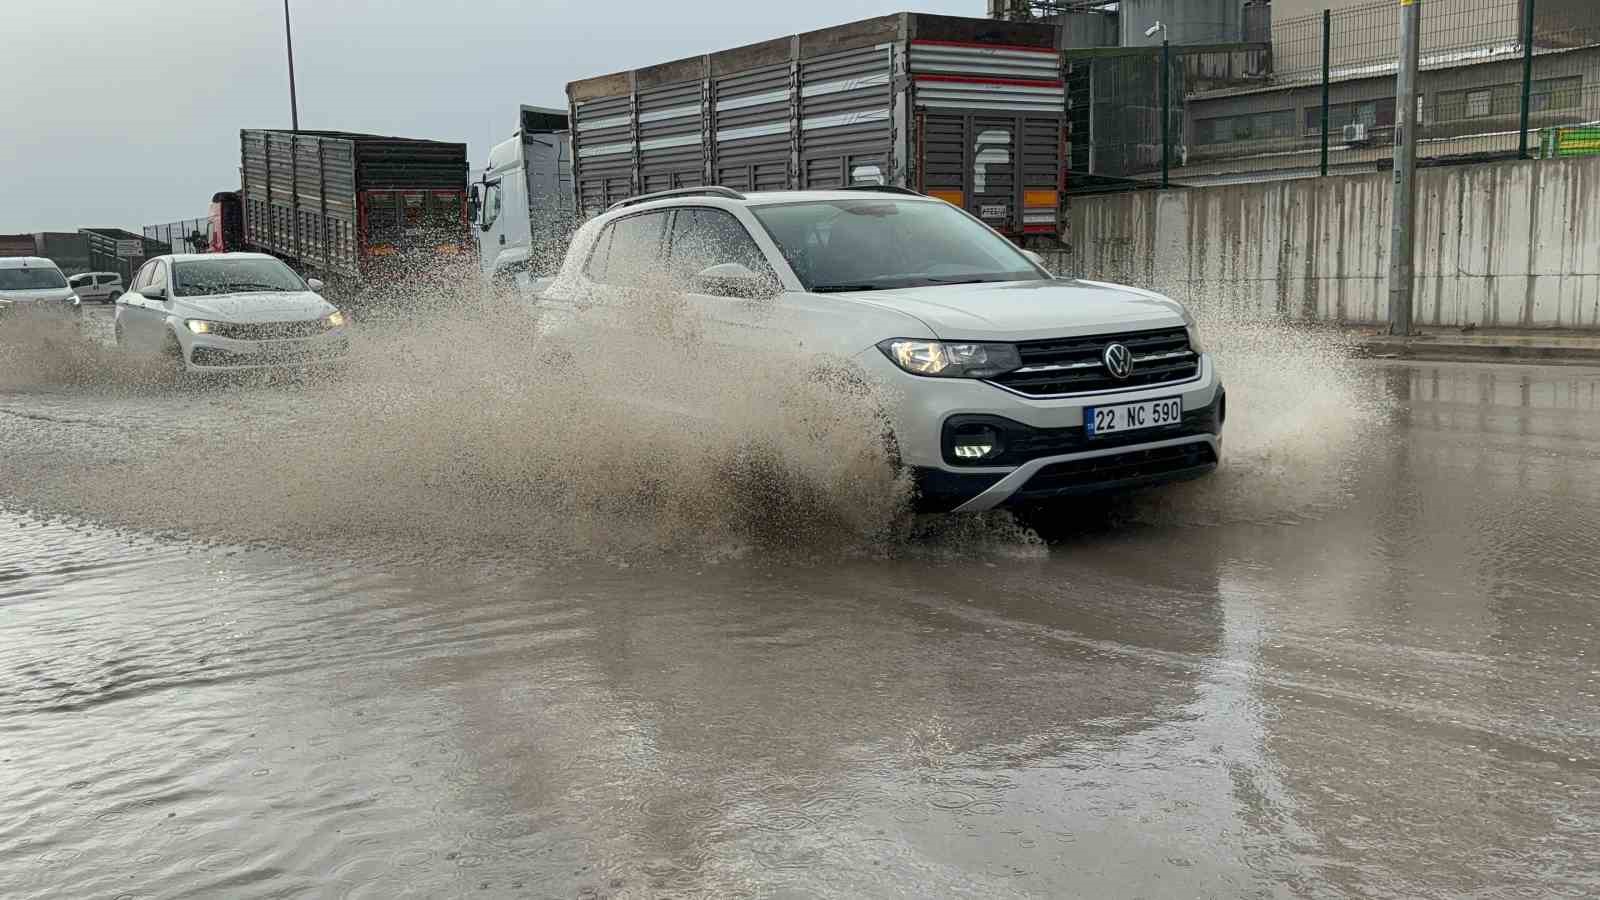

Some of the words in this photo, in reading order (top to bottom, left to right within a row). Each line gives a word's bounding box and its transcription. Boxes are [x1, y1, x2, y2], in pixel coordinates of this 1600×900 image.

[1095, 409, 1115, 431] 22
[1127, 406, 1145, 427] NC
[1152, 401, 1179, 423] 590
